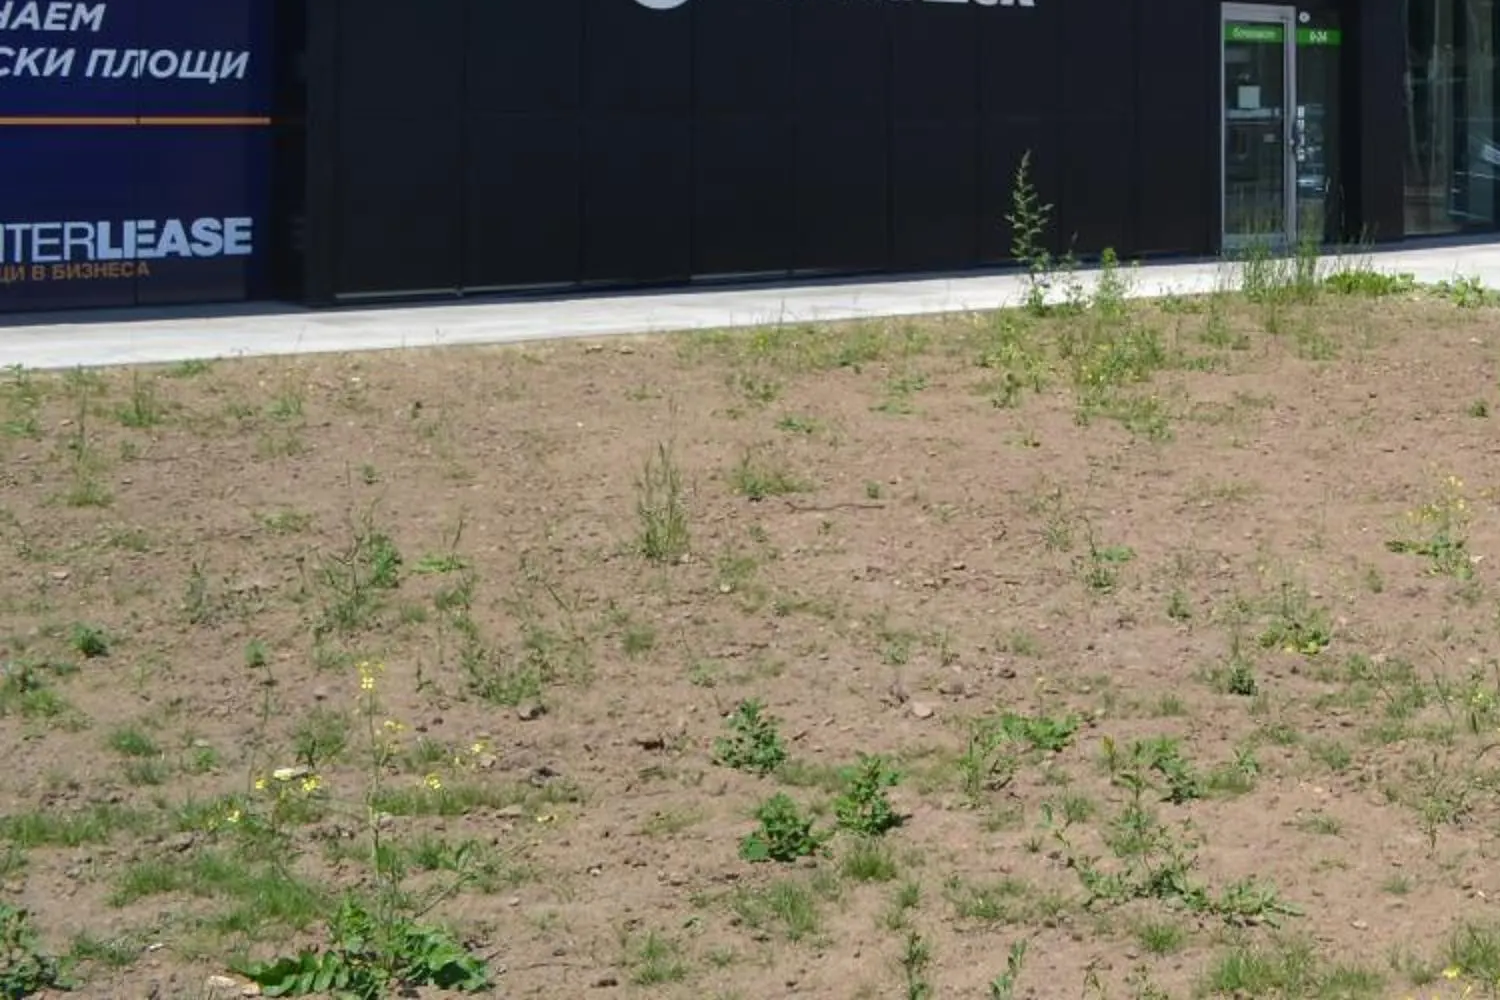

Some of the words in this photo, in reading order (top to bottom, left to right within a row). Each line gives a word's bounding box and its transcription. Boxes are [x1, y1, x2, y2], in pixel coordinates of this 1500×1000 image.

[85, 48, 250, 84] ПЛОЩИ
[0, 217, 253, 262] TERLEASE
[52, 261, 150, 280] БИЗНЕСА
